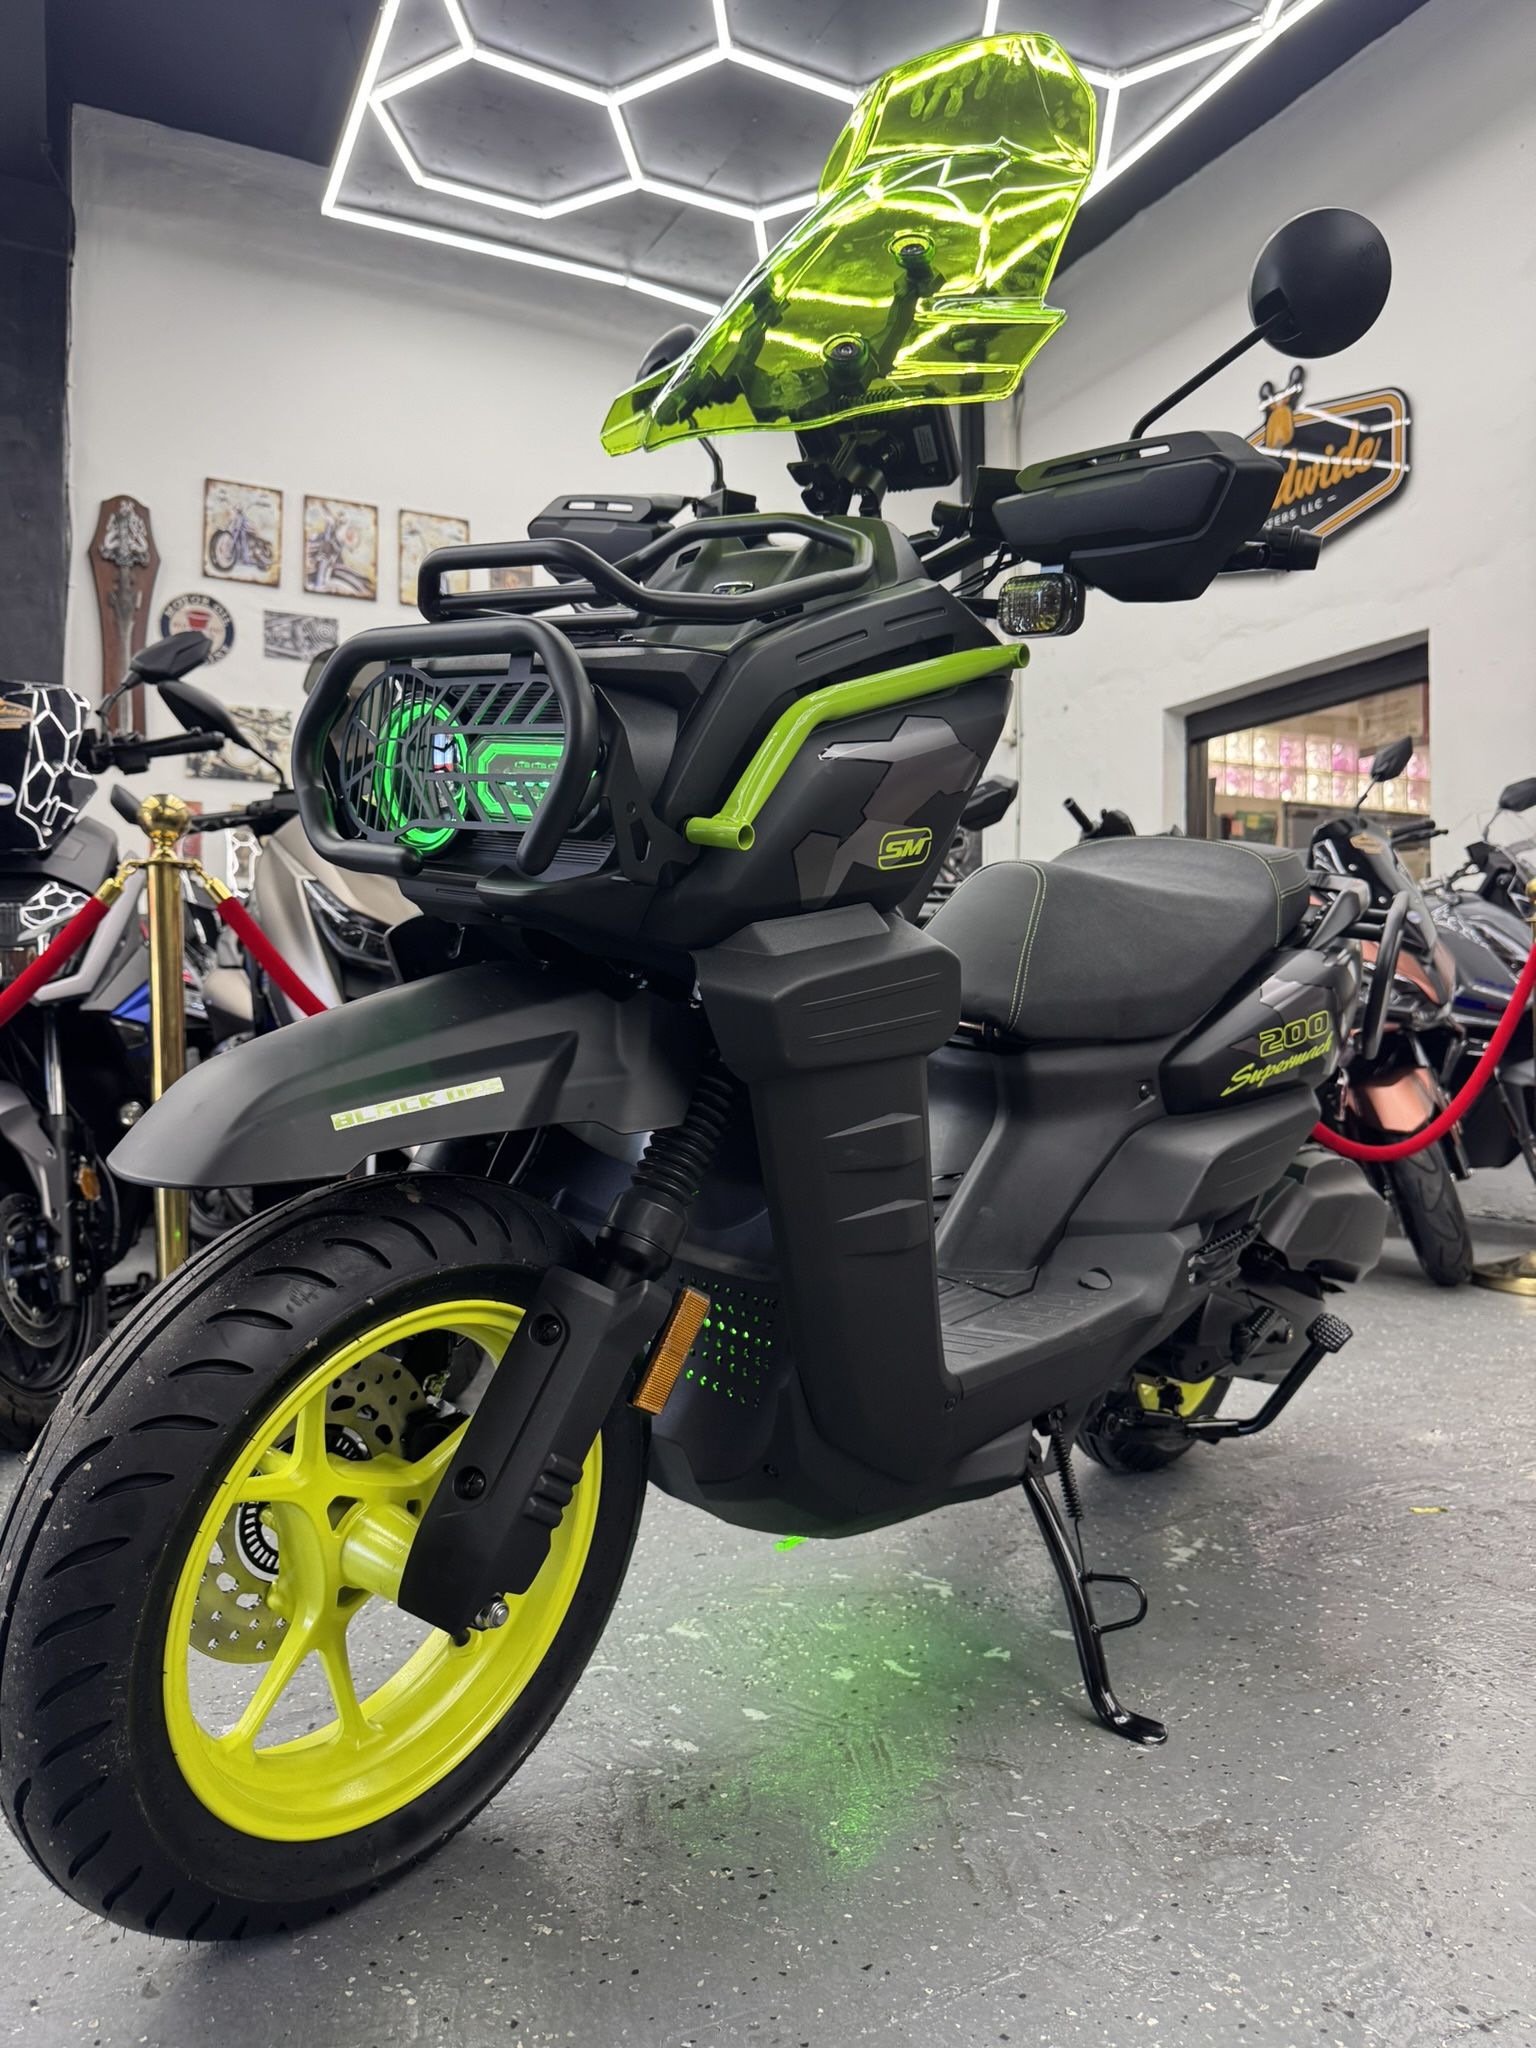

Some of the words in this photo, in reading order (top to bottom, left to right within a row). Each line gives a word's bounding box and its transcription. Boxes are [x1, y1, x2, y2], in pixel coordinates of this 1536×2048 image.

[1272, 421, 1382, 509] dwide
[1301, 497, 1323, 516] LLC
[165, 596, 210, 618] MOTOR
[881, 836, 931, 860] SM
[1259, 1010, 1330, 1058] 200
[332, 1095, 440, 1130] BLACK
[446, 1078, 503, 1103] OPS
